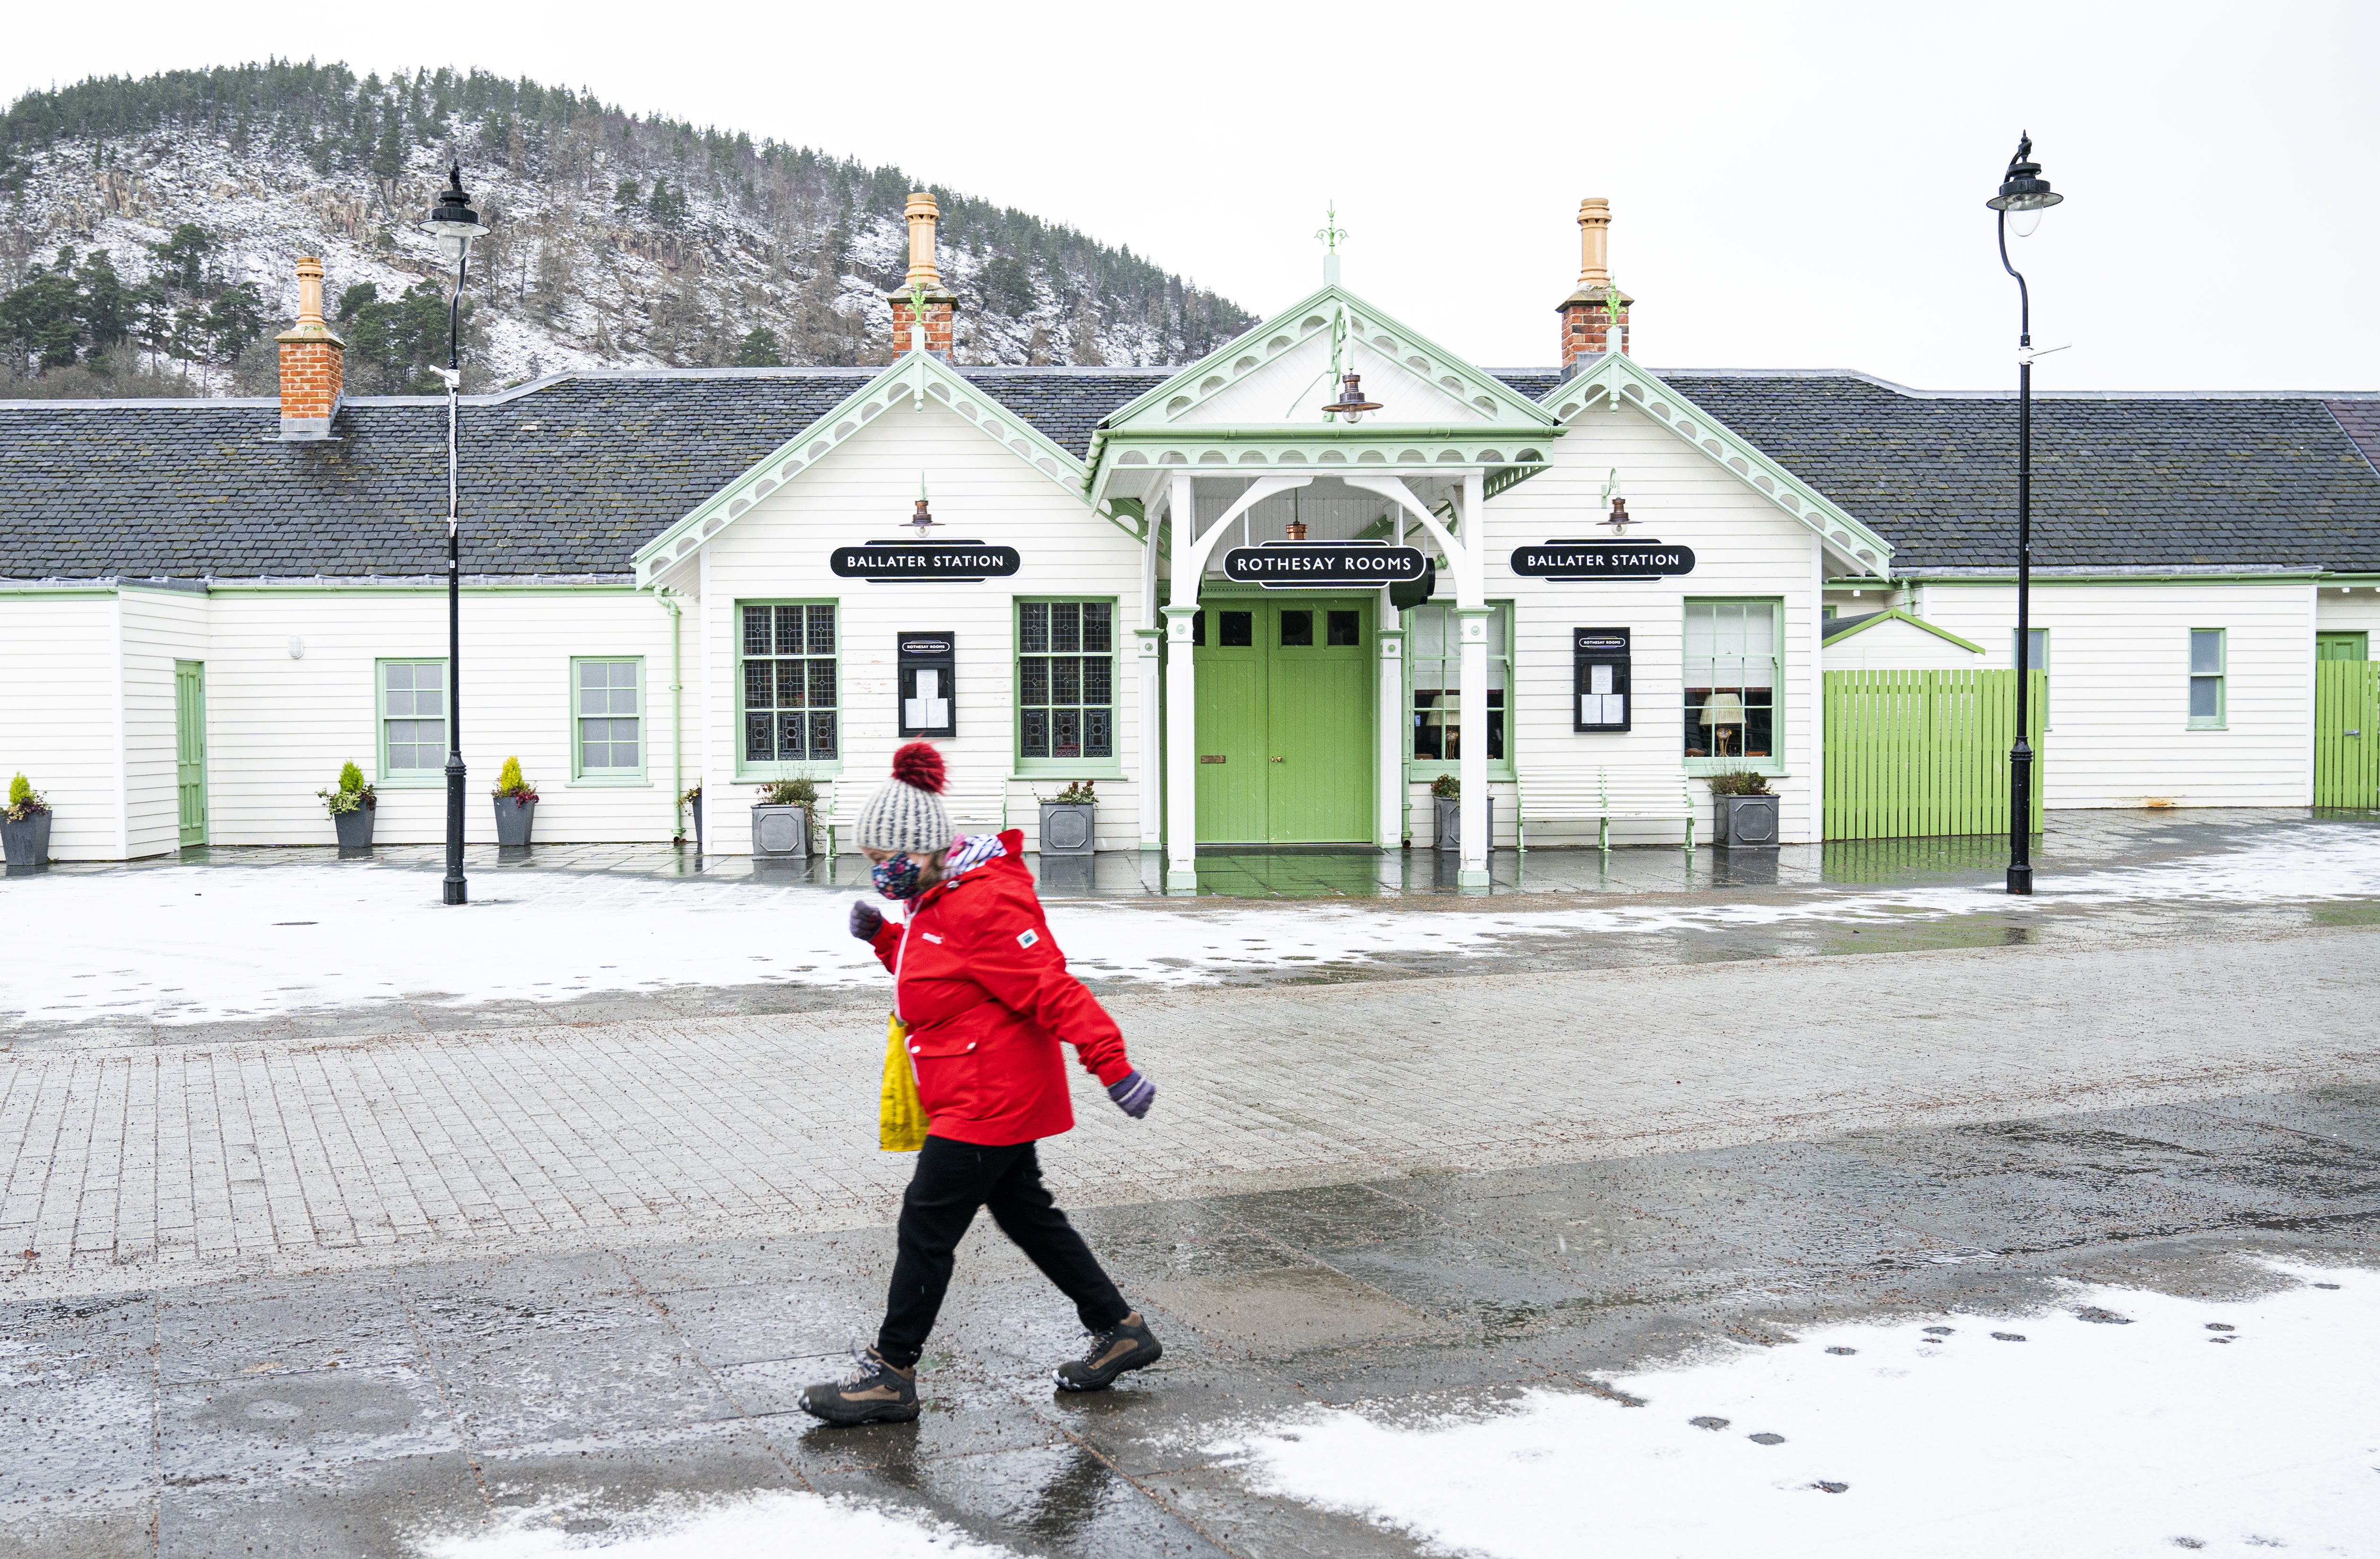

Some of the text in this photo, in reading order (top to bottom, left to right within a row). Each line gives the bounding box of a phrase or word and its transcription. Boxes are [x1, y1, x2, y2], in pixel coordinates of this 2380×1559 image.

[847, 555, 1003, 567] BALLATER STATION
[1237, 557, 1411, 571] ROTHESAY ROOMS
[1528, 554, 1679, 567] BALLATER STATION
